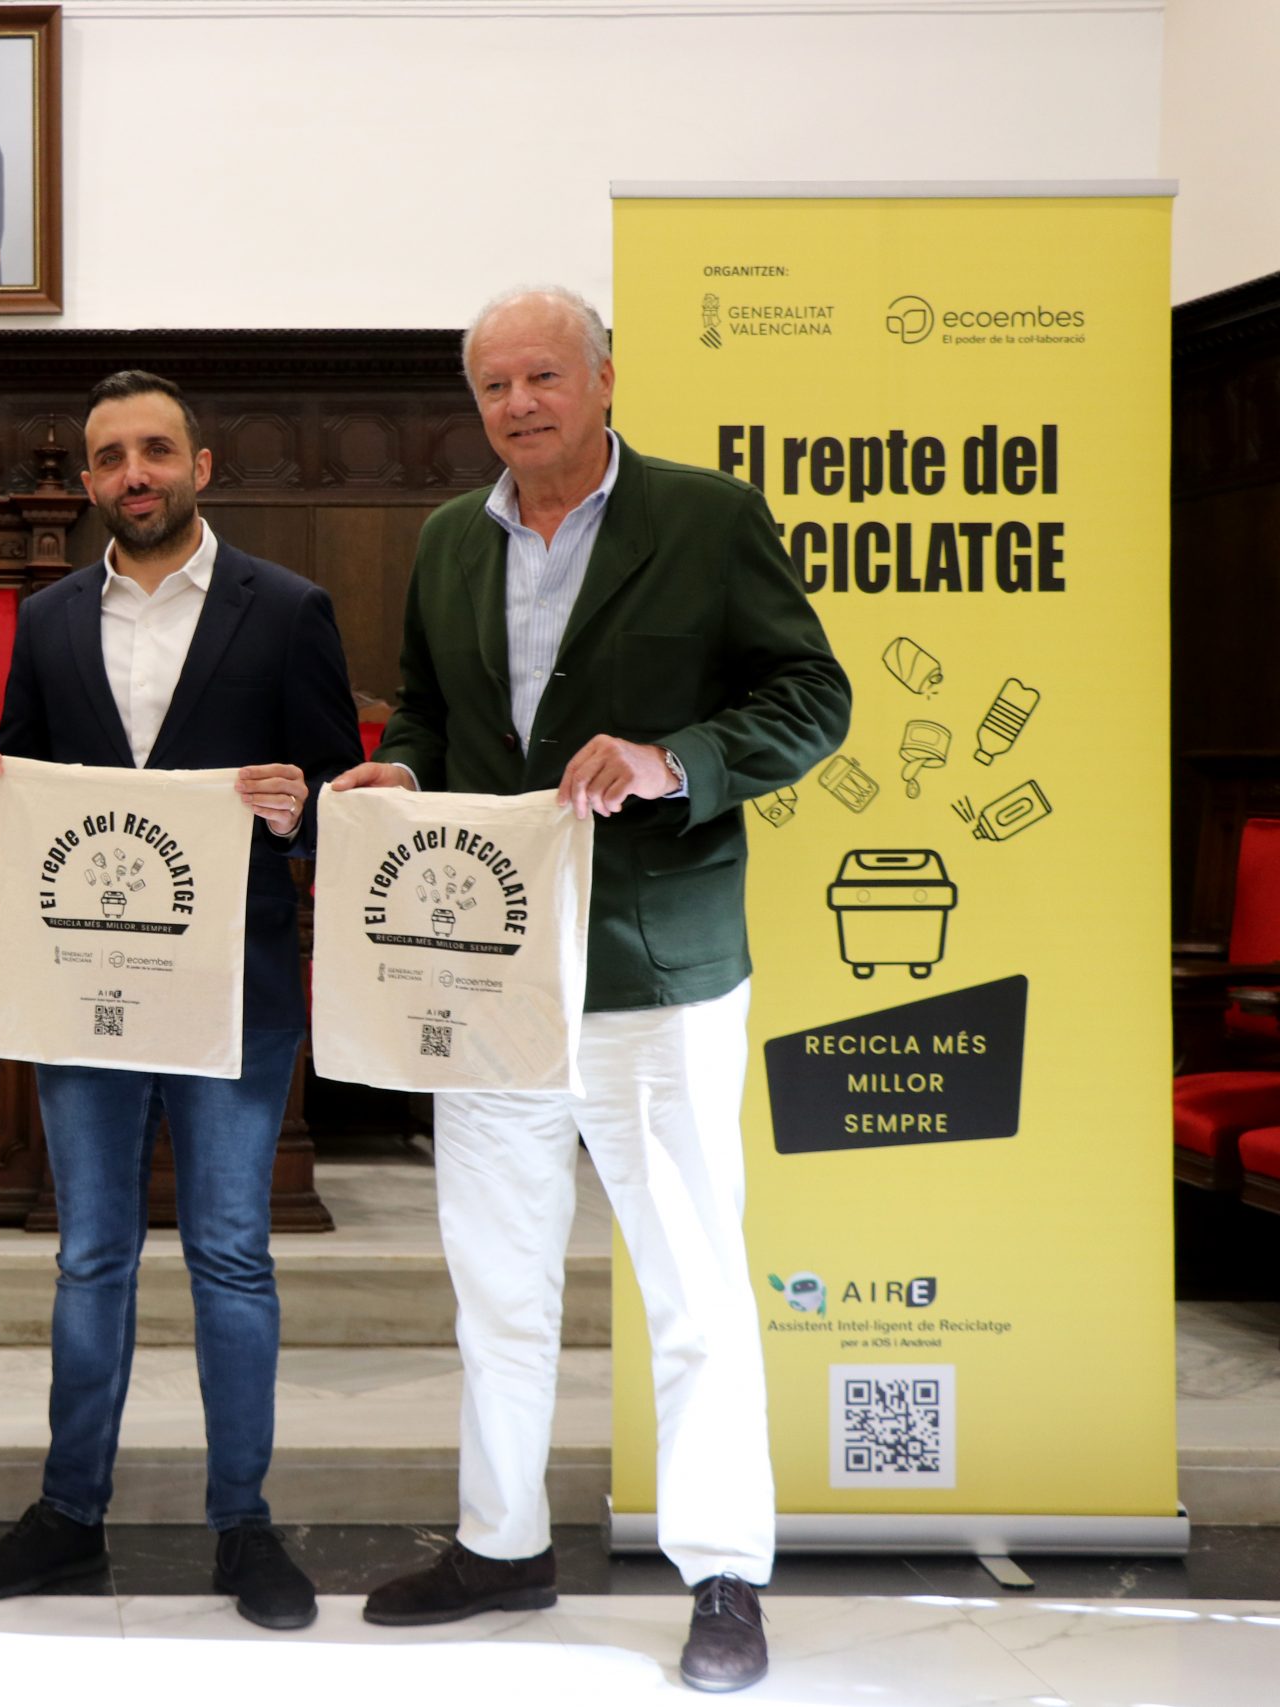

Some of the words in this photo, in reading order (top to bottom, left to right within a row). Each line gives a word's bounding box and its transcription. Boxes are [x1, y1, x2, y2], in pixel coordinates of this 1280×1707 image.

[703, 266, 789, 276] ORGANITZEN:
[728, 306, 834, 319] GENERALITAT
[943, 305, 1084, 327] ecoembes
[730, 323, 832, 335] VALENCIANA
[943, 335, 952, 343] El
[956, 335, 986, 345] poder
[990, 335, 1003, 343] de
[1006, 335, 1015, 343] la
[719, 426, 764, 495] El
[782, 430, 946, 503] repte
[963, 424, 1058, 495] del
[776, 522, 1065, 593] CICLATGE
[83, 811, 115, 837] del
[413, 827, 445, 852] del
[41, 829, 80, 883] repte
[124, 813, 194, 915] RECICLATGE
[370, 844, 411, 897] repte
[455, 829, 528, 935] RECICLATGE
[40, 892, 56, 909] El
[49, 919, 81, 927] RECICLA
[365, 907, 386, 924] El
[376, 934, 413, 944] RECICLA
[470, 945, 503, 953] SEMPRE
[127, 956, 173, 966] ecoembes
[456, 976, 503, 988] ecoembes
[806, 1035, 920, 1054] RECICLA
[933, 1030, 987, 1054] MÉS
[847, 1073, 944, 1093] MILLOR
[844, 1113, 948, 1133] SEMPRE
[841, 1279, 932, 1305] AIRE
[768, 1320, 832, 1332] Assistent
[918, 1320, 935, 1331] de
[939, 1319, 1012, 1334] Reciclatge
[841, 1339, 858, 1349] per
[900, 1337, 941, 1347] Android
